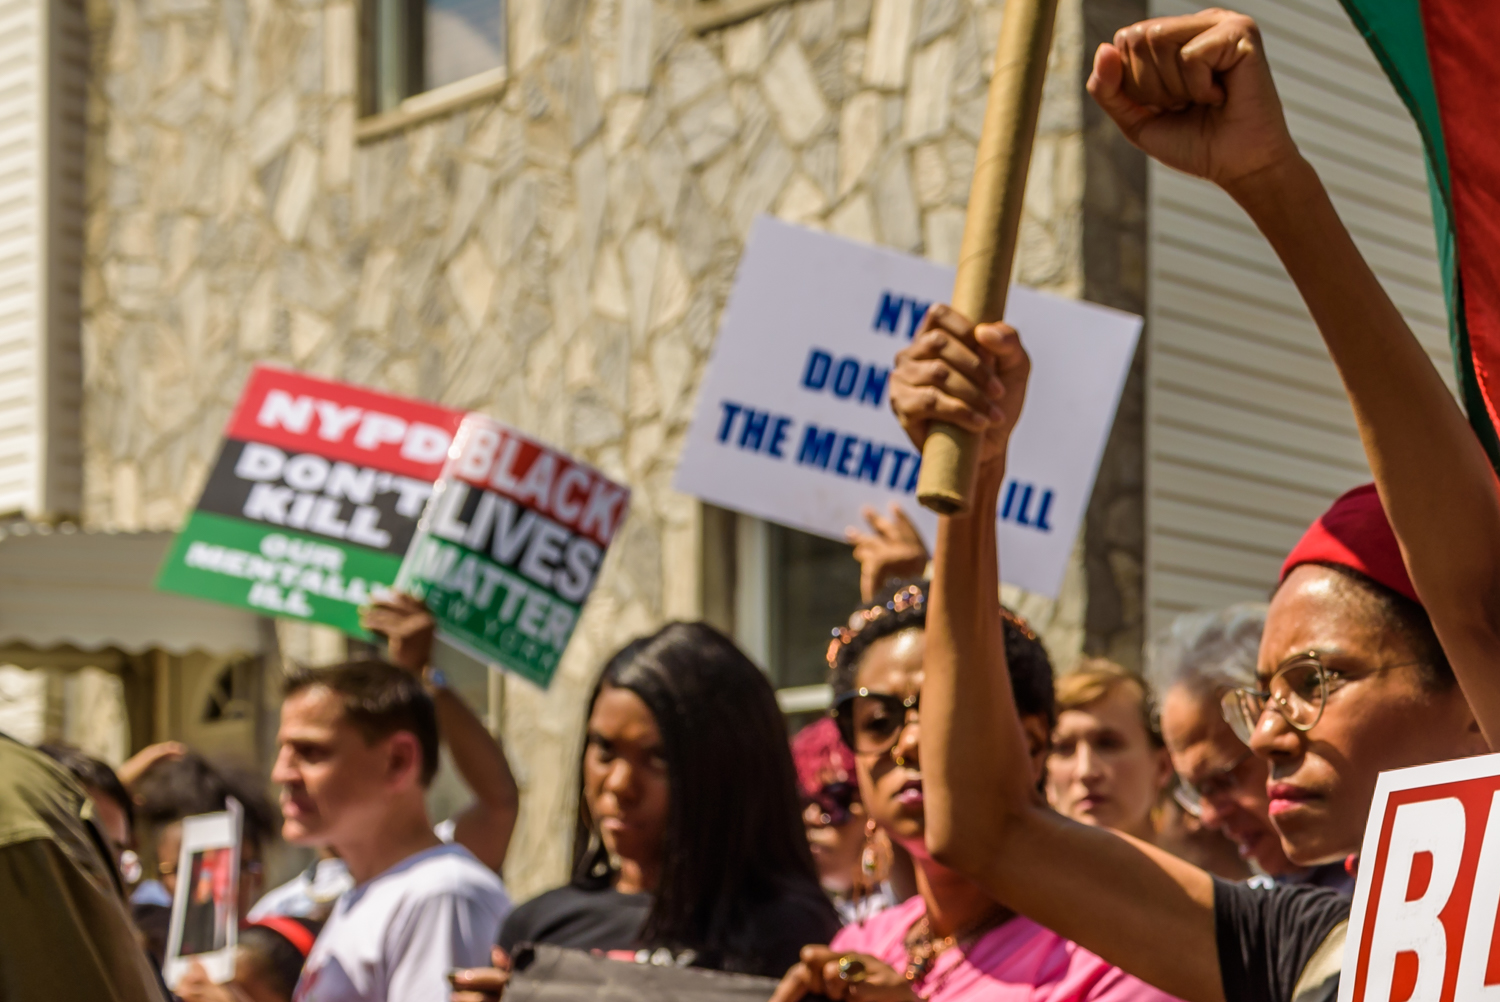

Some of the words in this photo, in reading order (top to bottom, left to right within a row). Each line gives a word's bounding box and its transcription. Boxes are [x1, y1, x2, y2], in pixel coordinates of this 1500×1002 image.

[871, 289, 930, 340] NY
[801, 348, 889, 410] DON
[257, 388, 454, 463] NYPD
[234, 440, 434, 518] DON'T
[460, 428, 622, 546] BLACK
[718, 402, 792, 459] THE
[1002, 480, 1055, 534] ILL
[243, 482, 393, 548] KILL
[259, 533, 346, 572] OUR
[434, 473, 600, 603] LIVES
[247, 581, 315, 617] ILL
[409, 537, 576, 650] MATTER
